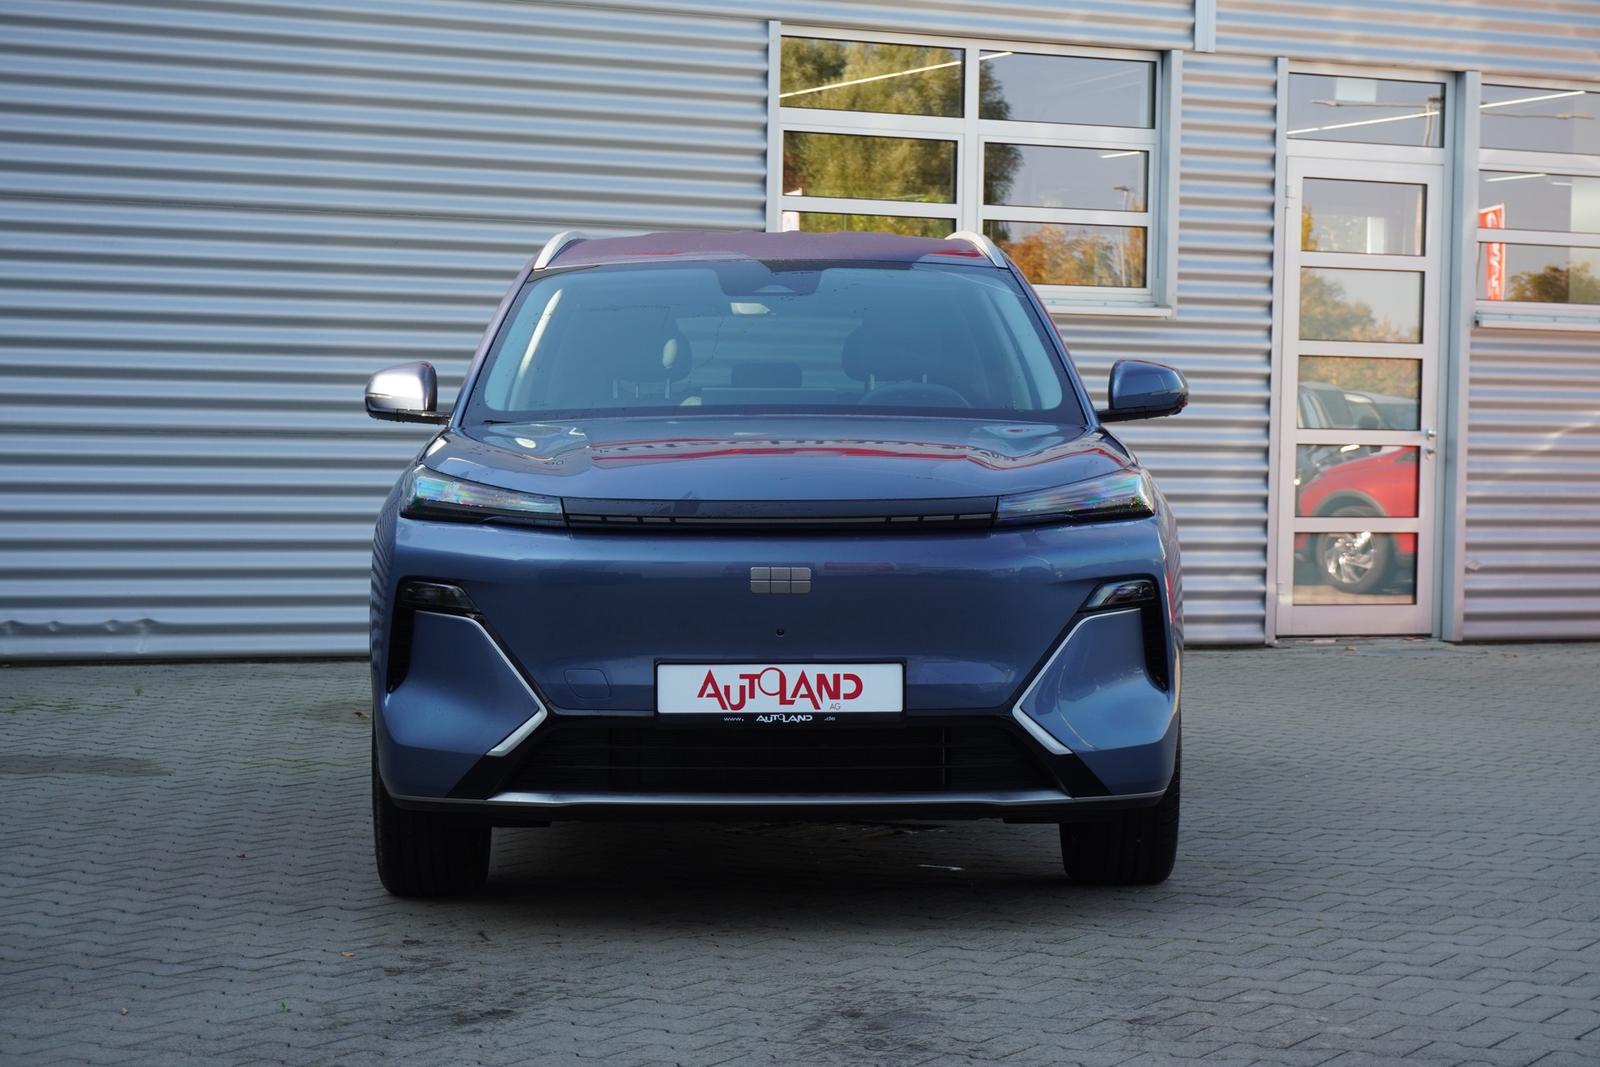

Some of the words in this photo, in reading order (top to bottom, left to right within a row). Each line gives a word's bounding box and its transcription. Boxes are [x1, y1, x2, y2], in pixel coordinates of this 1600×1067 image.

[697, 667, 863, 710] AUTOLAND
[829, 703, 841, 711] AG
[756, 714, 813, 723] AUTOLAND
